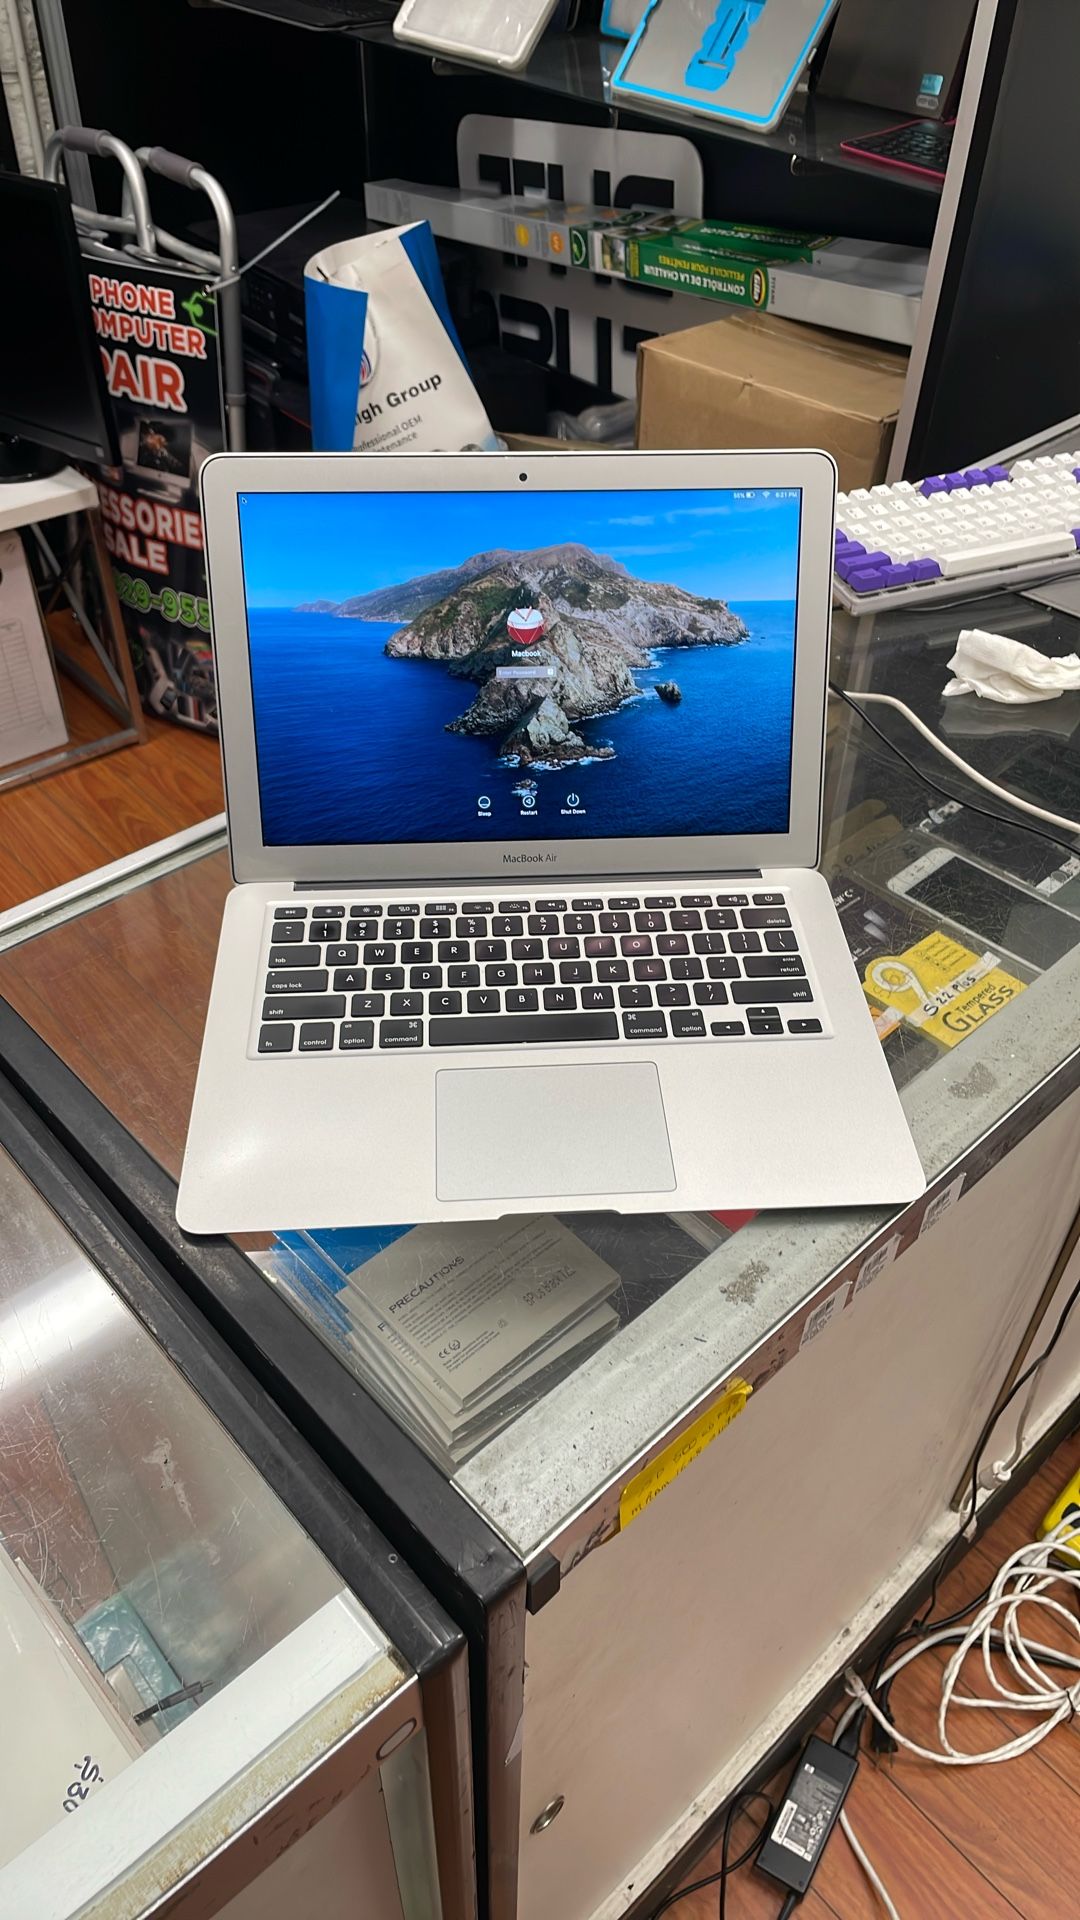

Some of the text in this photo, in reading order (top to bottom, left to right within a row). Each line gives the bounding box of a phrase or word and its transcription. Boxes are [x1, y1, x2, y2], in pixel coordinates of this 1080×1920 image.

[89, 274, 176, 320] PHONE
[644, 264, 745, 296] CONTRÔLE DE LA CHALEUR
[386, 374, 442, 408] Group
[100, 484, 204, 550] ESSORIE
[103, 523, 169, 576] SALE
[511, 650, 541, 658] Macbook
[502, 853, 558, 863] MacBook Air
[941, 985, 1014, 1032] GLASS
[955, 982, 996, 1014] Tempered
[389, 1255, 465, 1314] PRECAUTIONS
